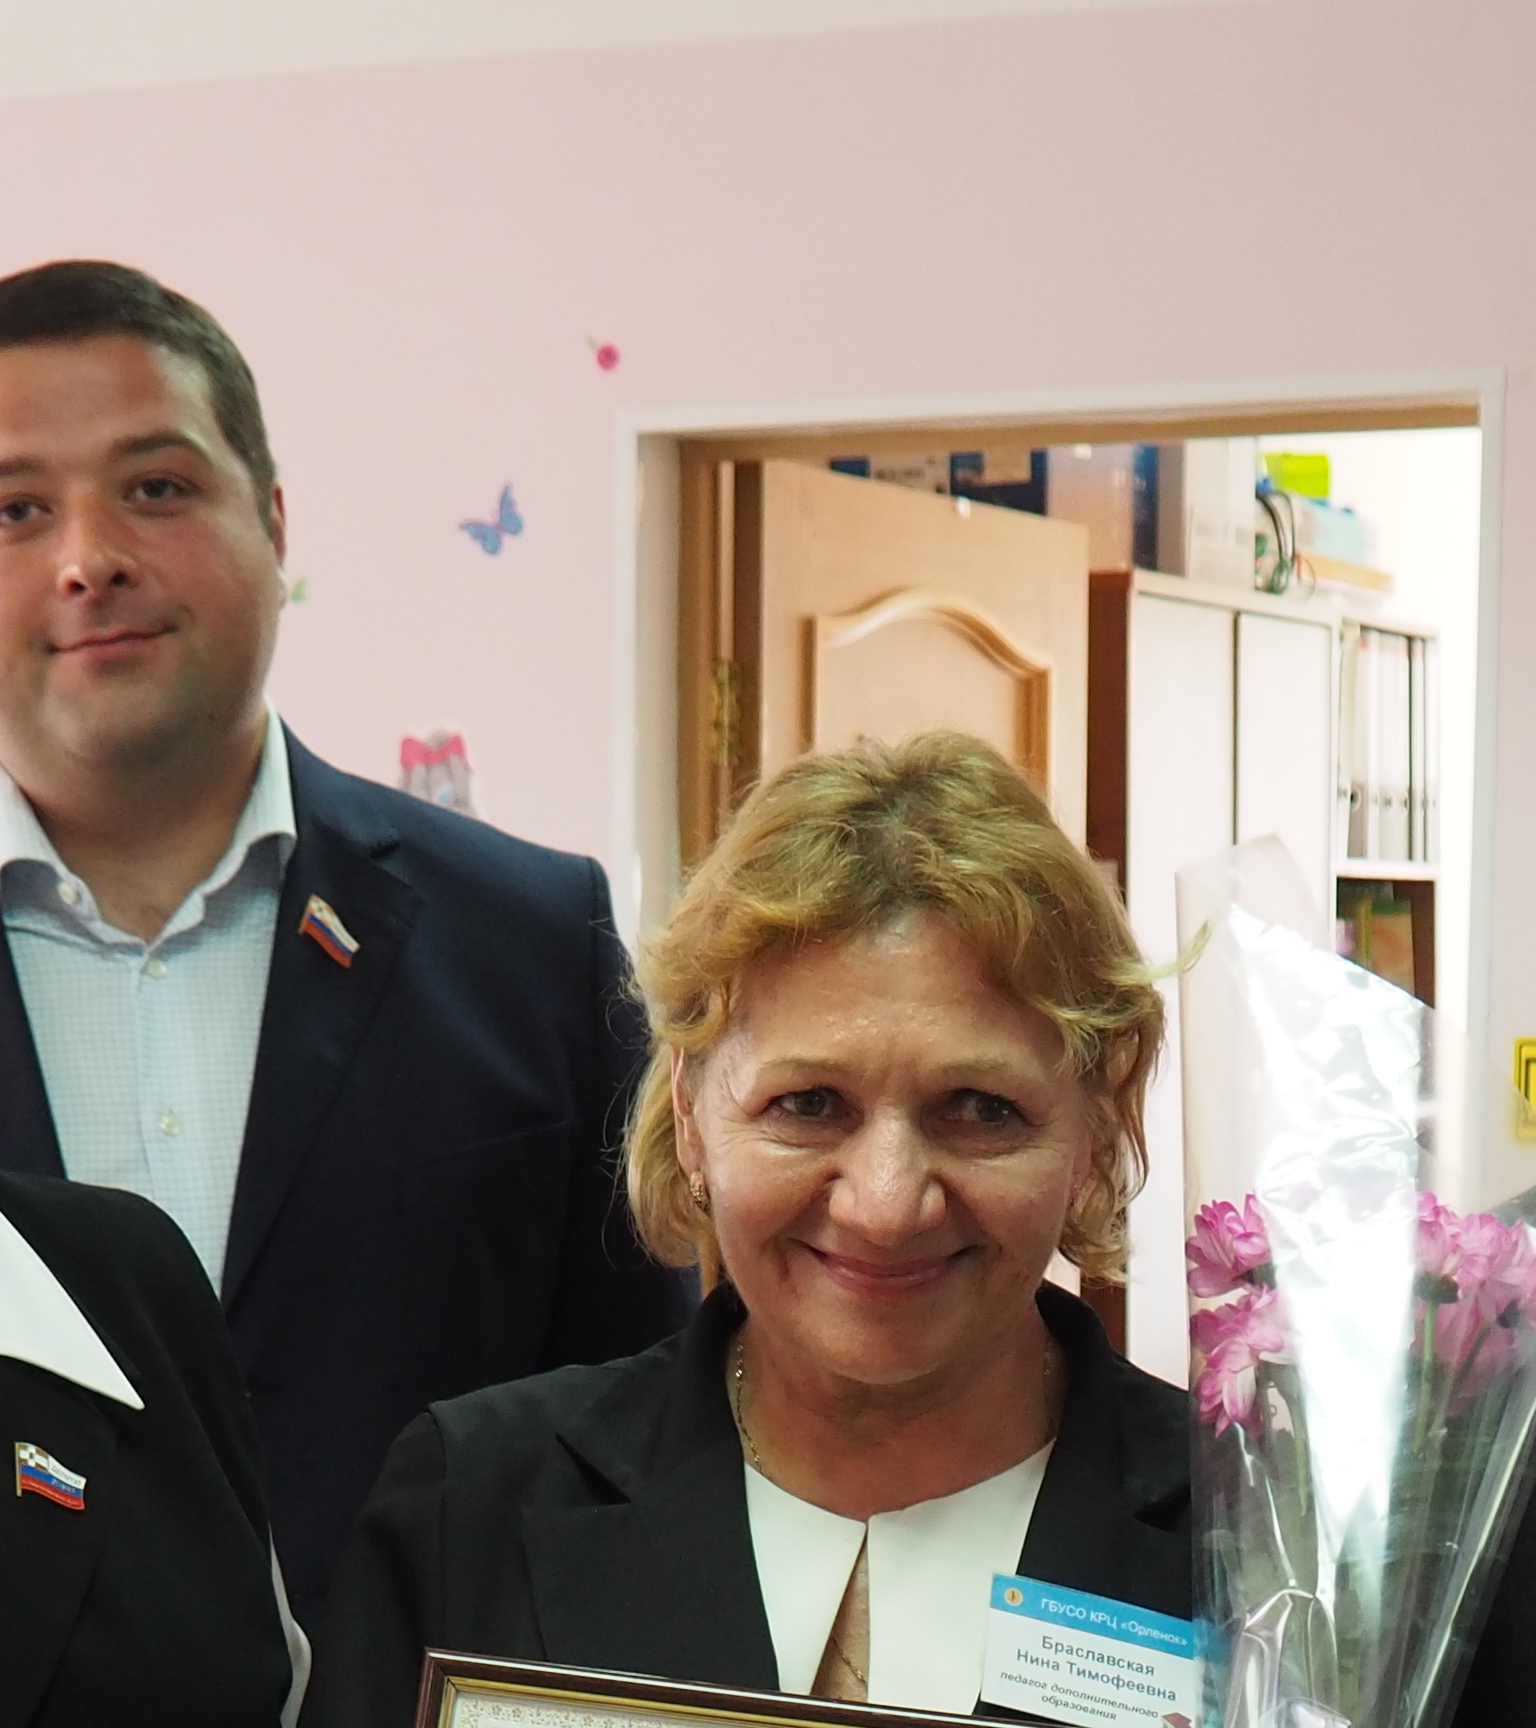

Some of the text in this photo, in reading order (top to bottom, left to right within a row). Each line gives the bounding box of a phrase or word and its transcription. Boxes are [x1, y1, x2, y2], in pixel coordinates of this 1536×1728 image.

[1041, 1598, 1086, 1620] ГБУСО
[1090, 1609, 1117, 1630] КРЦ
[1016, 1648, 1178, 1701] Нина Тимофеевна
[1041, 1635, 1155, 1677] Браславская
[1000, 1670, 1159, 1719] педагог дополнительного
[1041, 1694, 1117, 1721] образования
